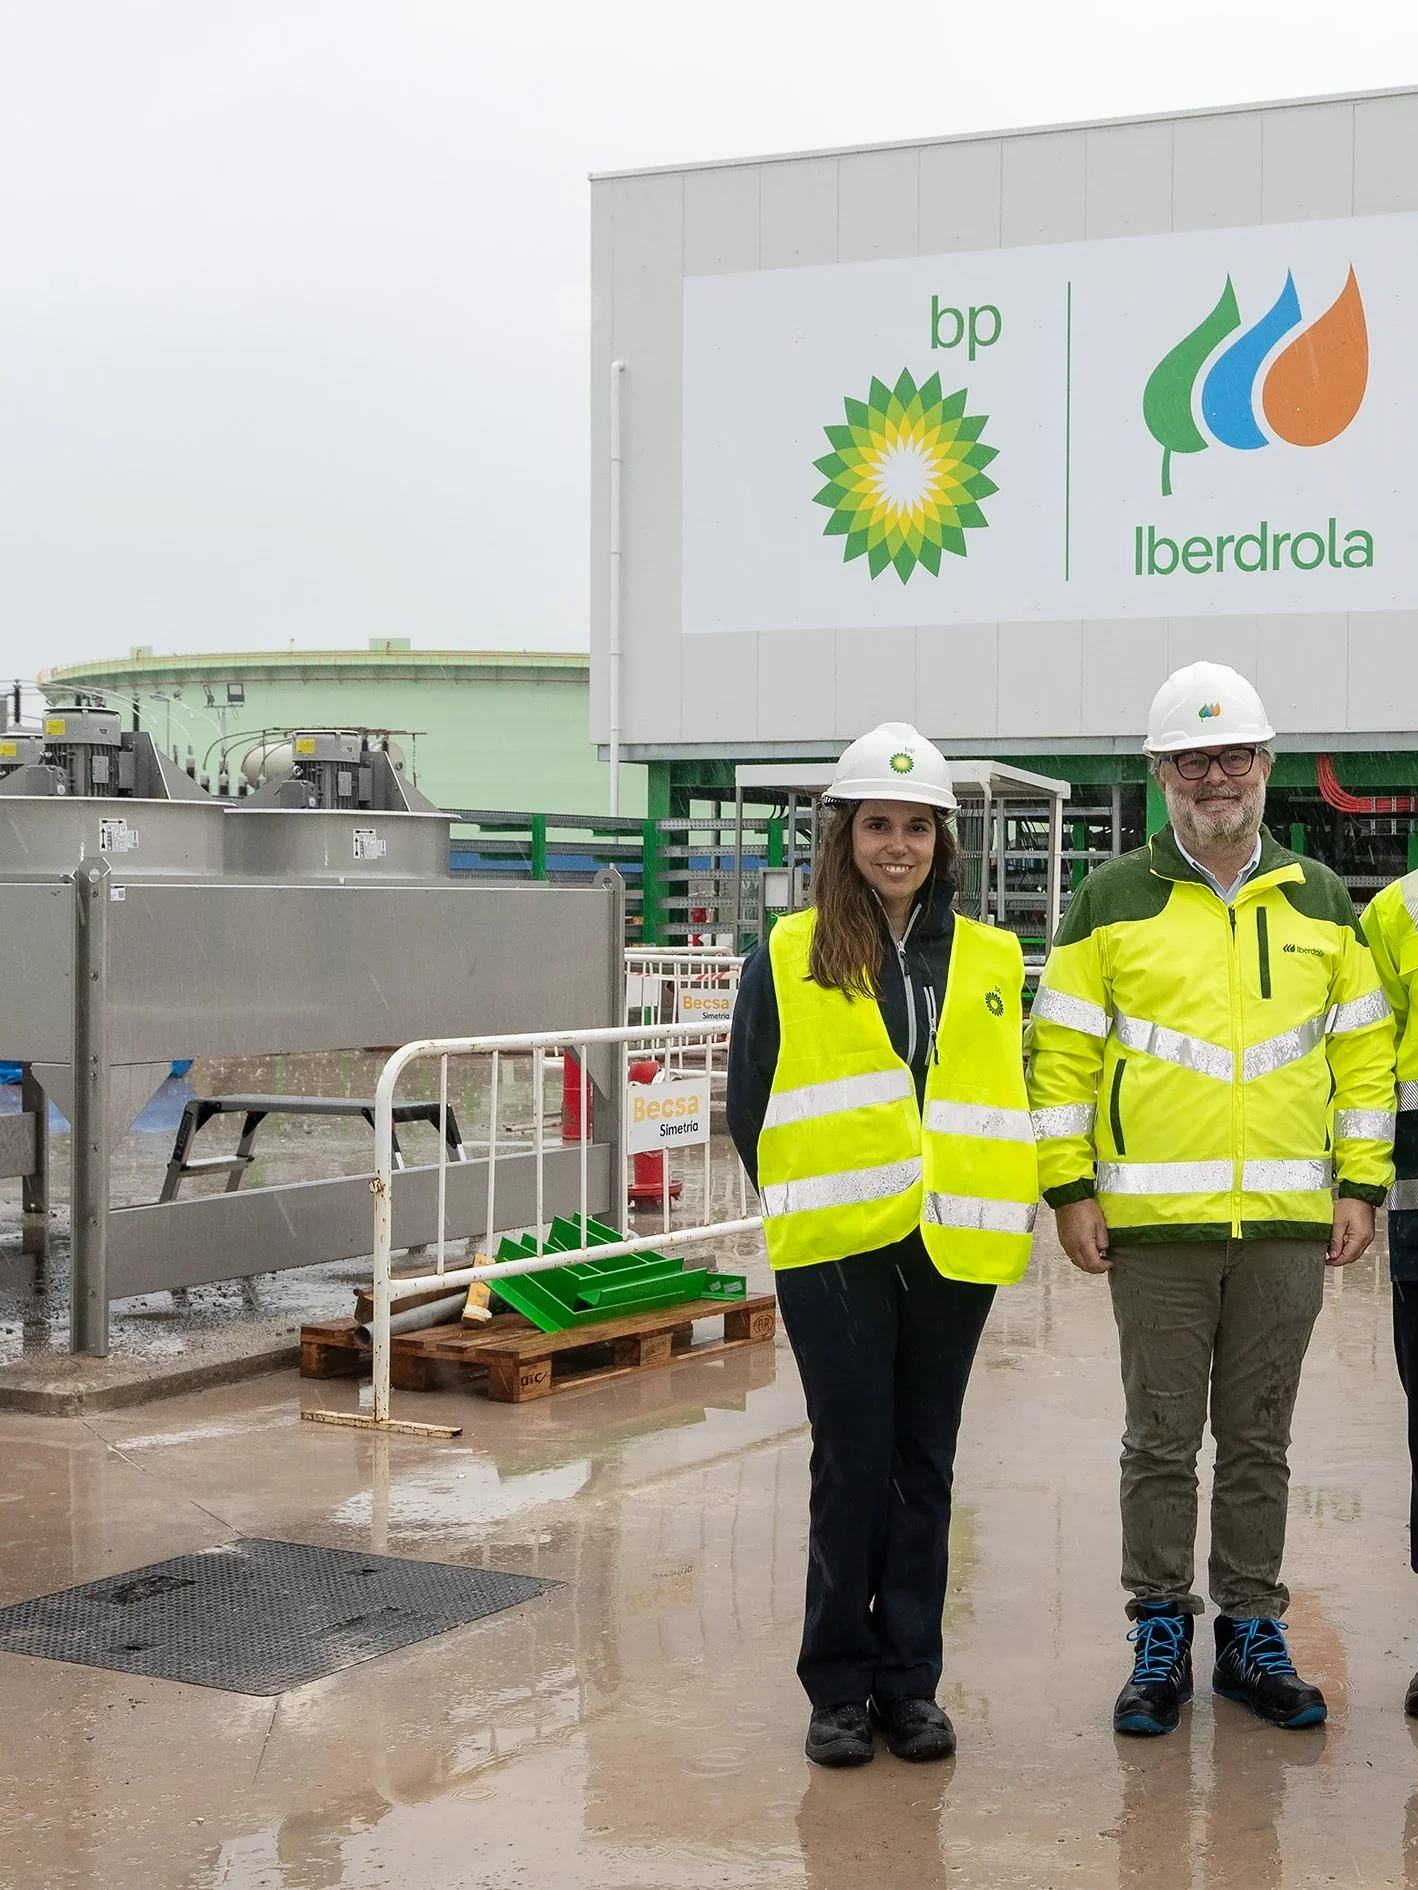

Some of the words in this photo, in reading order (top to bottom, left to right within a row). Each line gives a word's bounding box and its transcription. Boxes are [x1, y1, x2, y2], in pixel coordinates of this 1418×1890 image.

[931, 295, 1002, 361] bp
[1135, 517, 1374, 575] Iberdrola
[683, 995, 730, 1010] Becsa
[634, 1095, 699, 1123] Becsa
